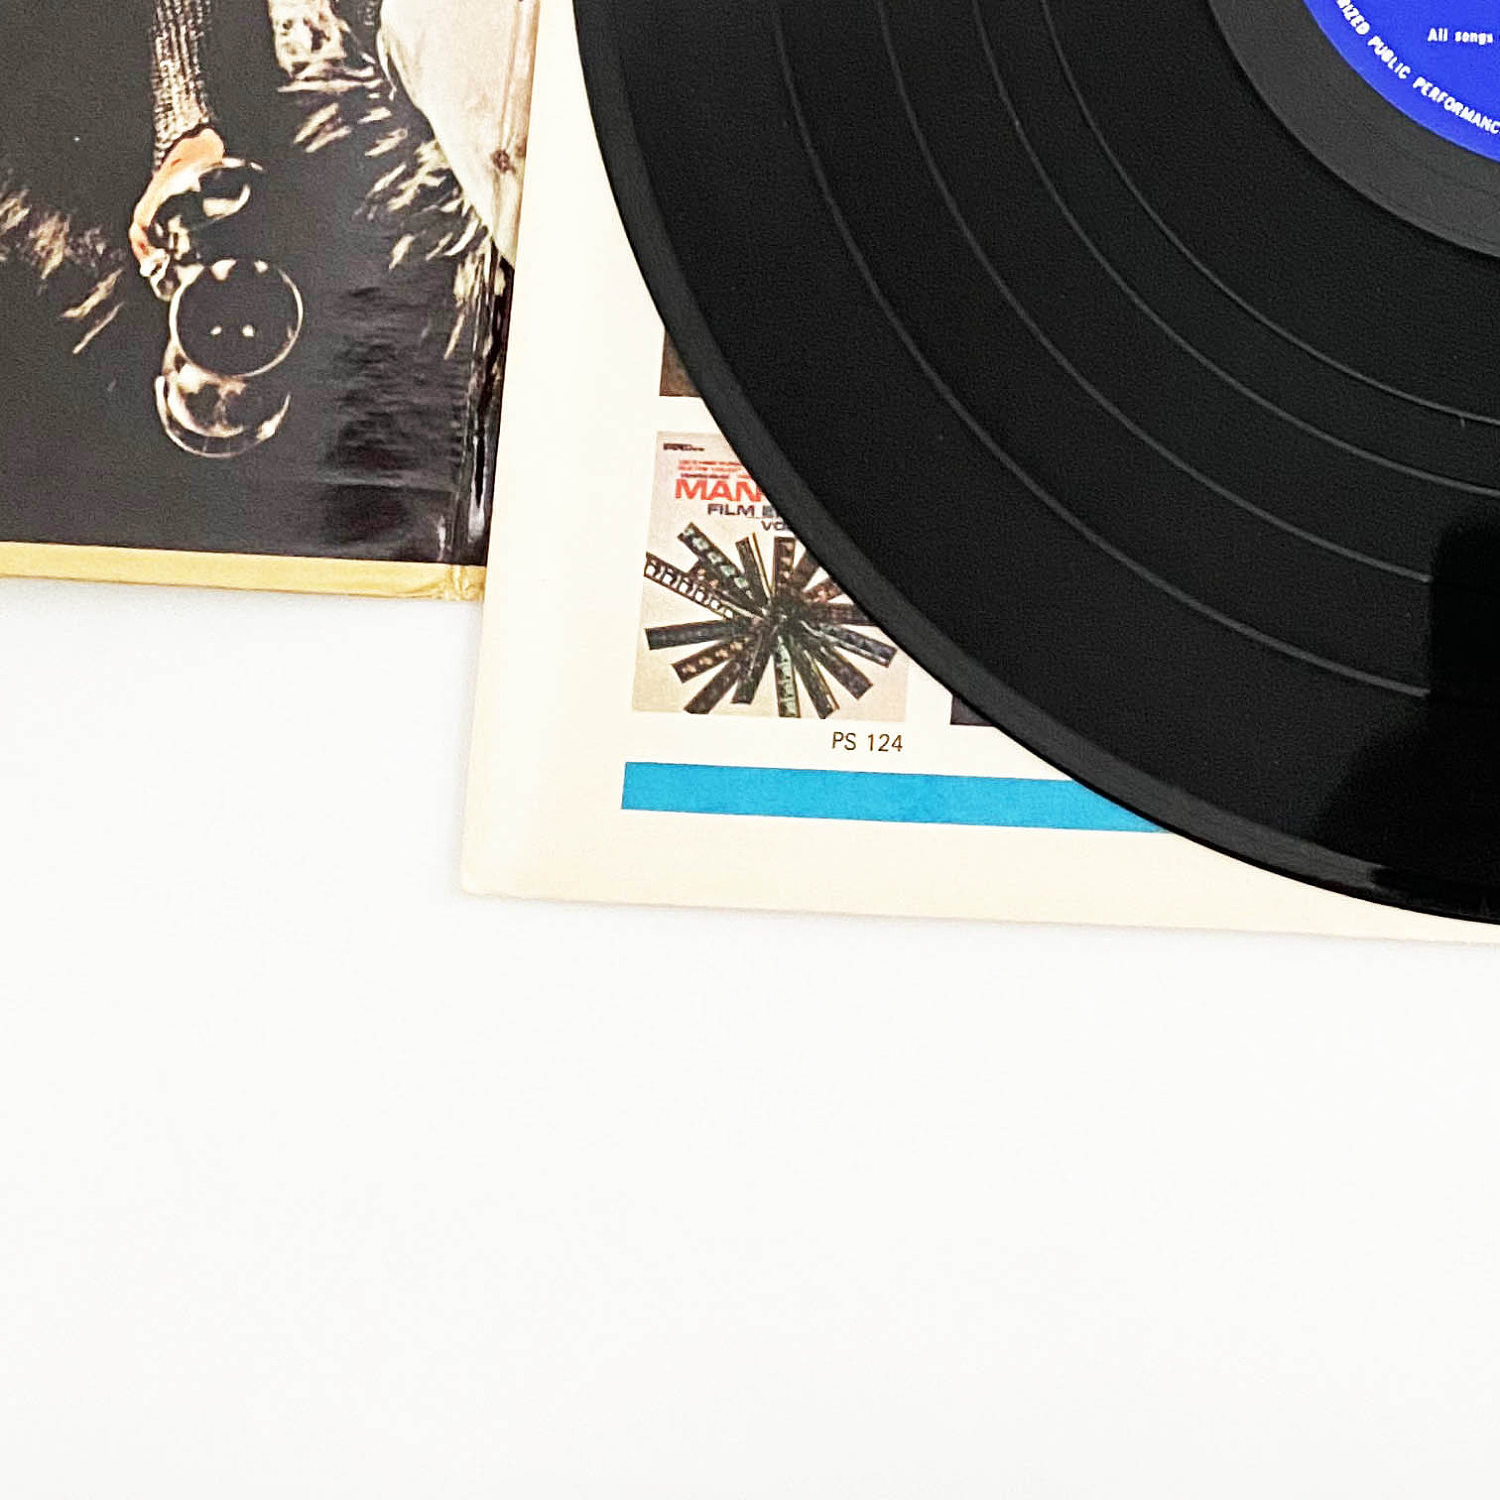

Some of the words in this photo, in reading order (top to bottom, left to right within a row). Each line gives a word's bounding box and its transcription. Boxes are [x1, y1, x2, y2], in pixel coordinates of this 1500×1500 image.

[1427, 27, 1448, 42] All
[1454, 31, 1494, 46] songs
[1367, 35, 1411, 79] PUBLIC
[707, 503, 755, 516] FILM
[832, 731, 857, 751] PS
[867, 733, 904, 752] 124
